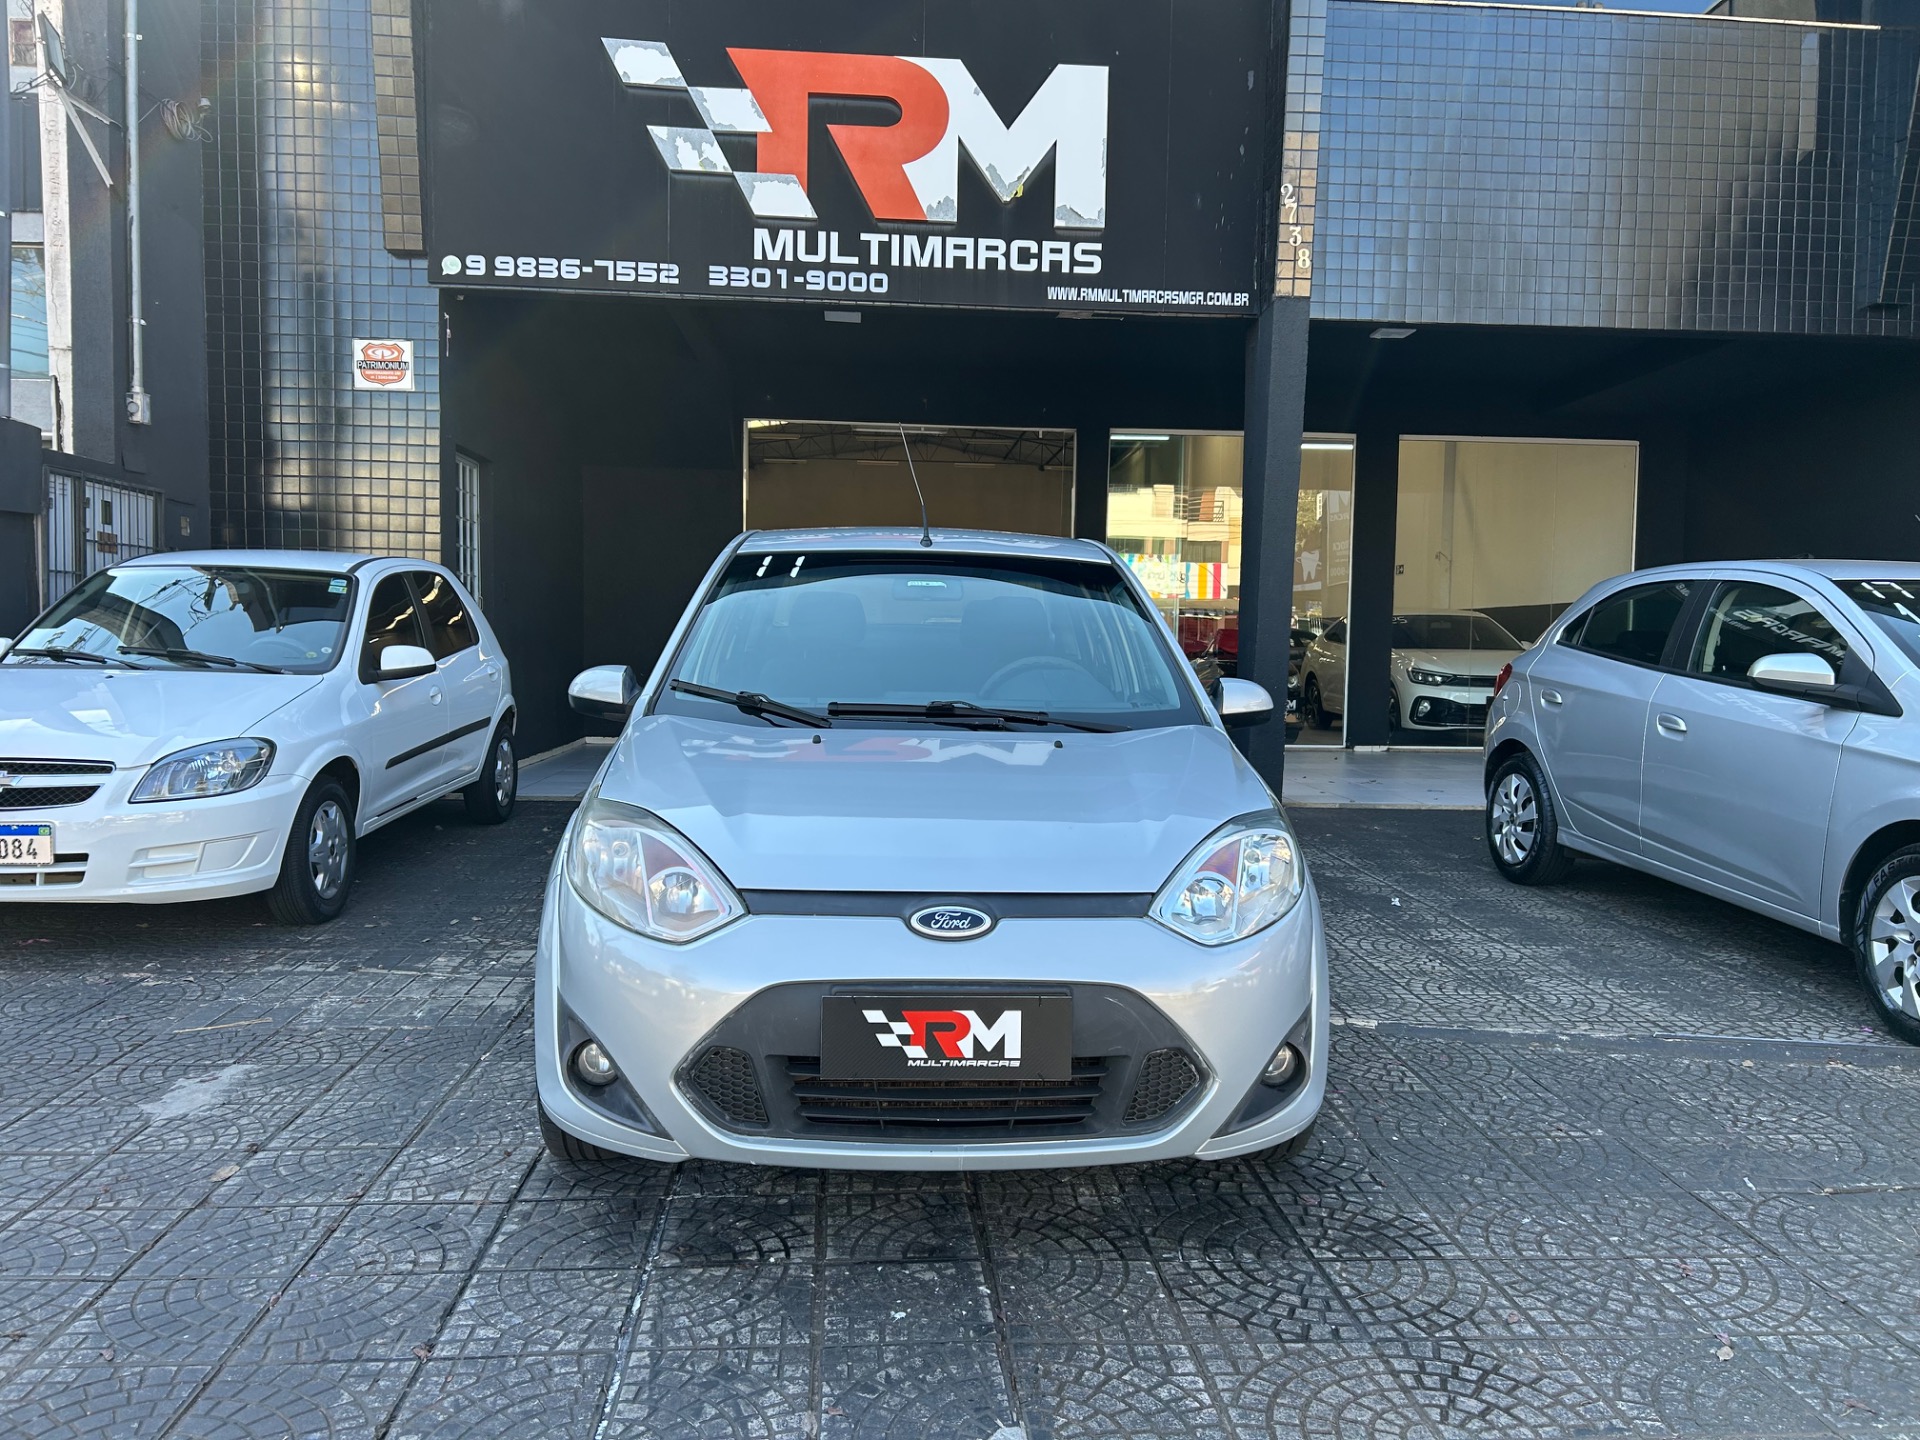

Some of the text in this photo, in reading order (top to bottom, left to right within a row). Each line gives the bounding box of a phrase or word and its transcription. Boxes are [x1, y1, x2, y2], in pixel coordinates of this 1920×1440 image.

[726, 47, 1110, 229] RM
[753, 228, 1103, 275] MULTIMARCAS
[465, 254, 680, 284] 9 9836-7552
[708, 265, 889, 293] 3301-9000
[357, 360, 409, 370] PATRIMONIUM
[930, 911, 972, 929] Ford
[902, 1009, 1022, 1059] RM
[907, 1059, 1021, 1068] MULTIMARCAS
